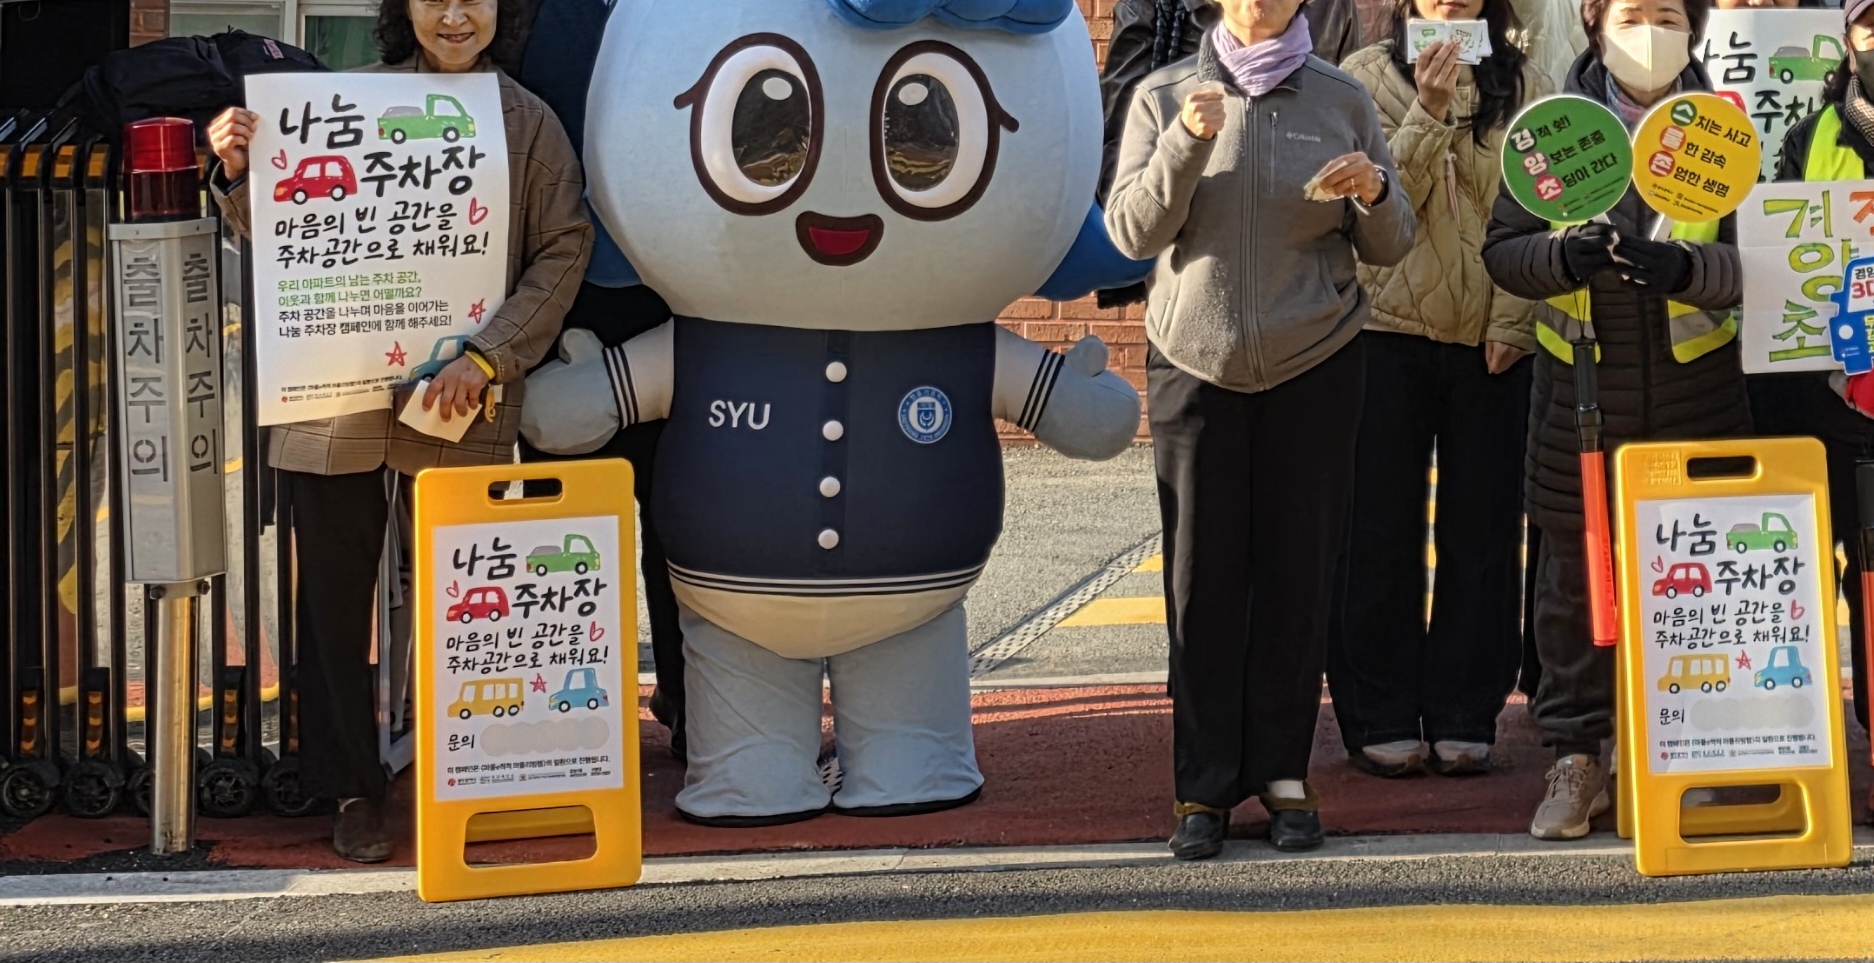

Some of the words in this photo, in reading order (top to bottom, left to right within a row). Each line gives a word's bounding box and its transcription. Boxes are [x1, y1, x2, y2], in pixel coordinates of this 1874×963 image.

[279, 94, 365, 149] 나눔
[1510, 123, 1552, 151] 경적
[1672, 104, 1722, 136] 스치는
[1723, 127, 1751, 147] 사고
[361, 145, 486, 196] 주차장
[1524, 145, 1578, 176] 양보는
[1577, 130, 1606, 152] 존중
[1700, 148, 1727, 169] 감속
[1538, 166, 1590, 200] 초딩아
[1590, 153, 1618, 174] 간다
[1650, 153, 1701, 187] 존엄한
[1702, 178, 1730, 198] 생명
[275, 212, 345, 239] 마음의
[355, 206, 377, 234] 빈
[387, 201, 457, 235] 공간을
[276, 237, 404, 269] 주차공간으로
[413, 231, 489, 257] 채워요!
[278, 280, 299, 292] 우리
[302, 276, 346, 290] 아파트의
[349, 274, 370, 287] 남는
[373, 273, 393, 285] 주차
[278, 294, 311, 307] 이웃과
[314, 292, 336, 305] 함께
[338, 289, 370, 302] 나누면
[373, 287, 422, 300] 어떨까요?
[279, 310, 300, 323] 주차
[304, 307, 336, 322] 공간을
[339, 304, 371, 318] 나누며
[373, 302, 405, 316] 마음을
[408, 300, 449, 313] 이어가는
[279, 325, 301, 338] 나눔
[305, 323, 336, 336] 주차장
[340, 320, 382, 334] 캠페인에
[385, 318, 406, 331] 함께
[408, 315, 452, 329] 해주세요!
[123, 255, 168, 483] 출차주의
[182, 252, 218, 475] 출차주의
[708, 400, 771, 430] SYU
[1656, 513, 1717, 557] 나눔
[453, 537, 517, 580] 나눔
[1714, 556, 1805, 596] 주차장
[512, 578, 607, 618] 주차장
[1653, 606, 1704, 628] 마음의
[1711, 603, 1727, 625] 빈
[1734, 600, 1785, 626] 공간을
[446, 632, 499, 651] 마음의
[507, 627, 523, 648] 빈
[531, 623, 584, 649] 공간을
[1655, 627, 1747, 650] 주차공간으로
[1753, 624, 1810, 644] 채워요!
[447, 651, 542, 674] 주차공간으로
[549, 646, 609, 666] 채워요!
[1659, 708, 1685, 726] 문의
[447, 734, 475, 752] 문의
